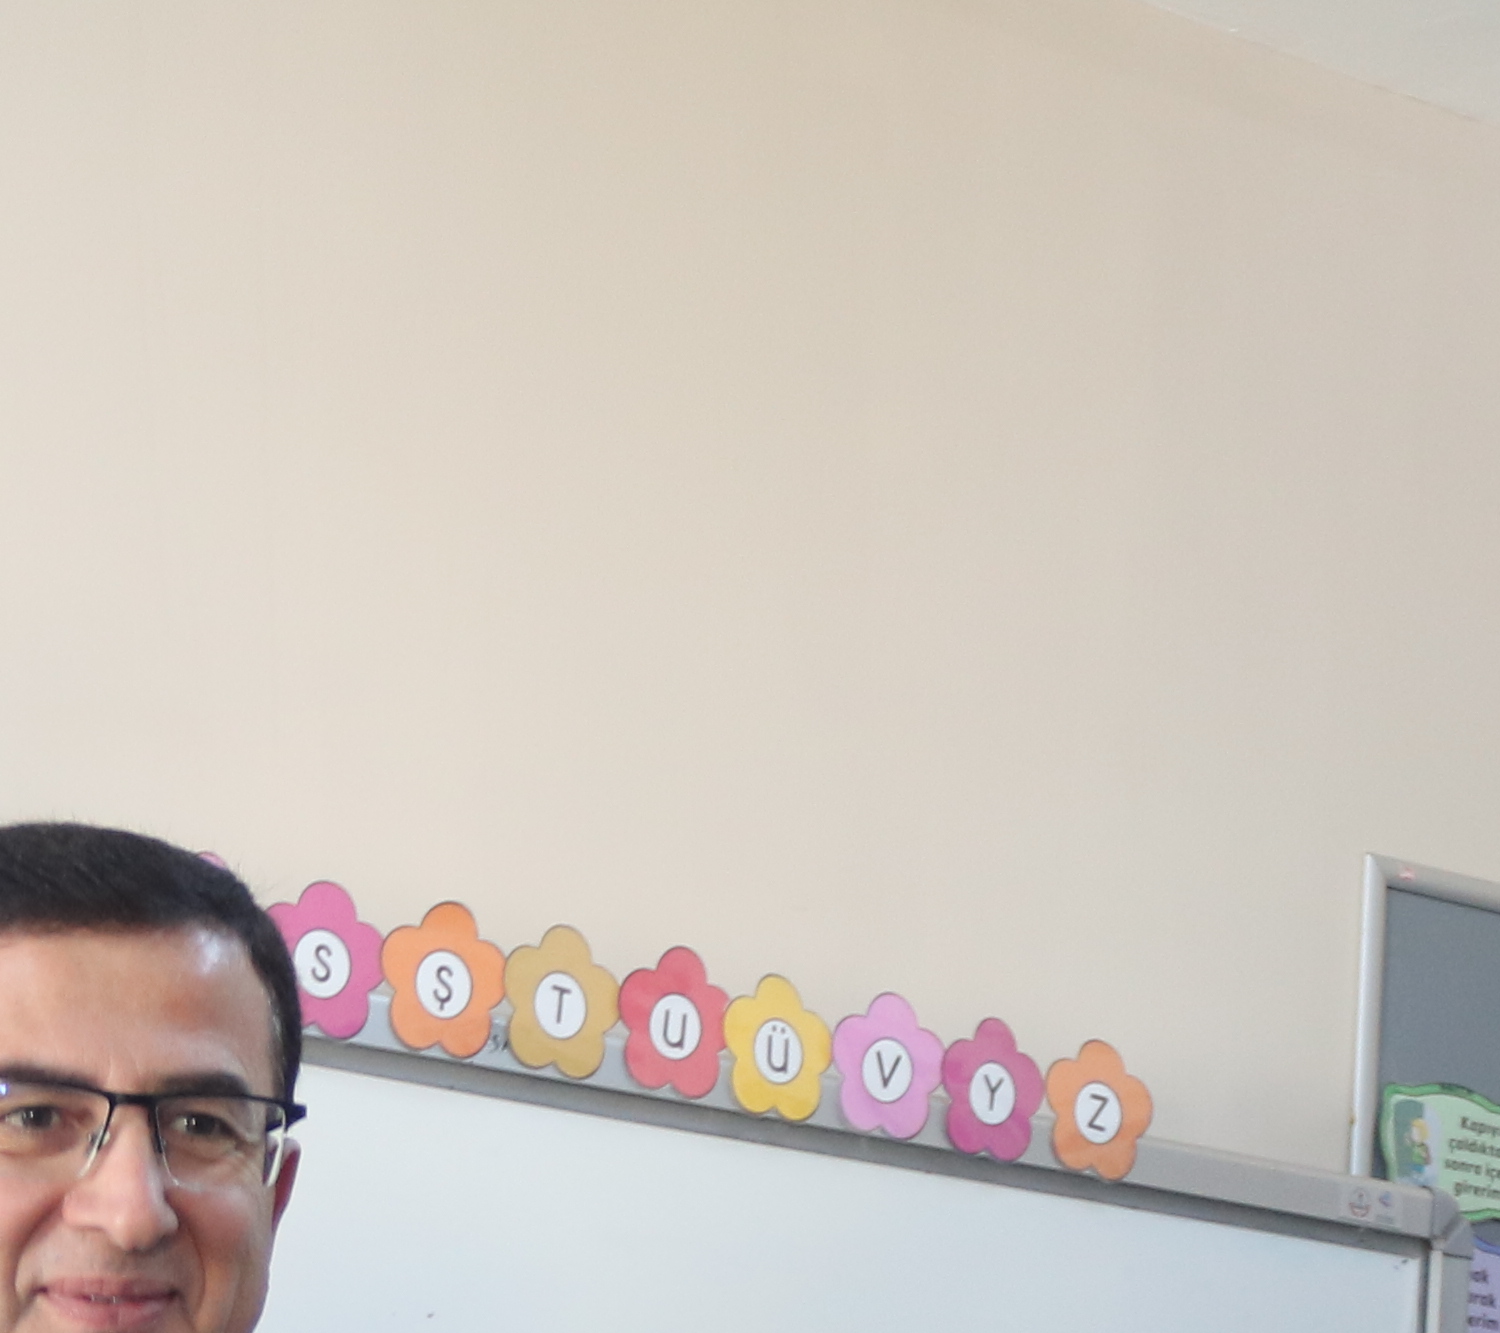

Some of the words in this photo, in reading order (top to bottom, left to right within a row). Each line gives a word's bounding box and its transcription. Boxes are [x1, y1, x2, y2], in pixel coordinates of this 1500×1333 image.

[310, 943, 332, 984] S
[432, 965, 454, 1012] Ş
[551, 984, 572, 1024] T
[662, 1009, 688, 1051] U
[766, 1025, 790, 1075] Ü
[876, 1050, 902, 1089] V
[983, 1074, 1005, 1111] Y
[1086, 1093, 1109, 1133] Z
